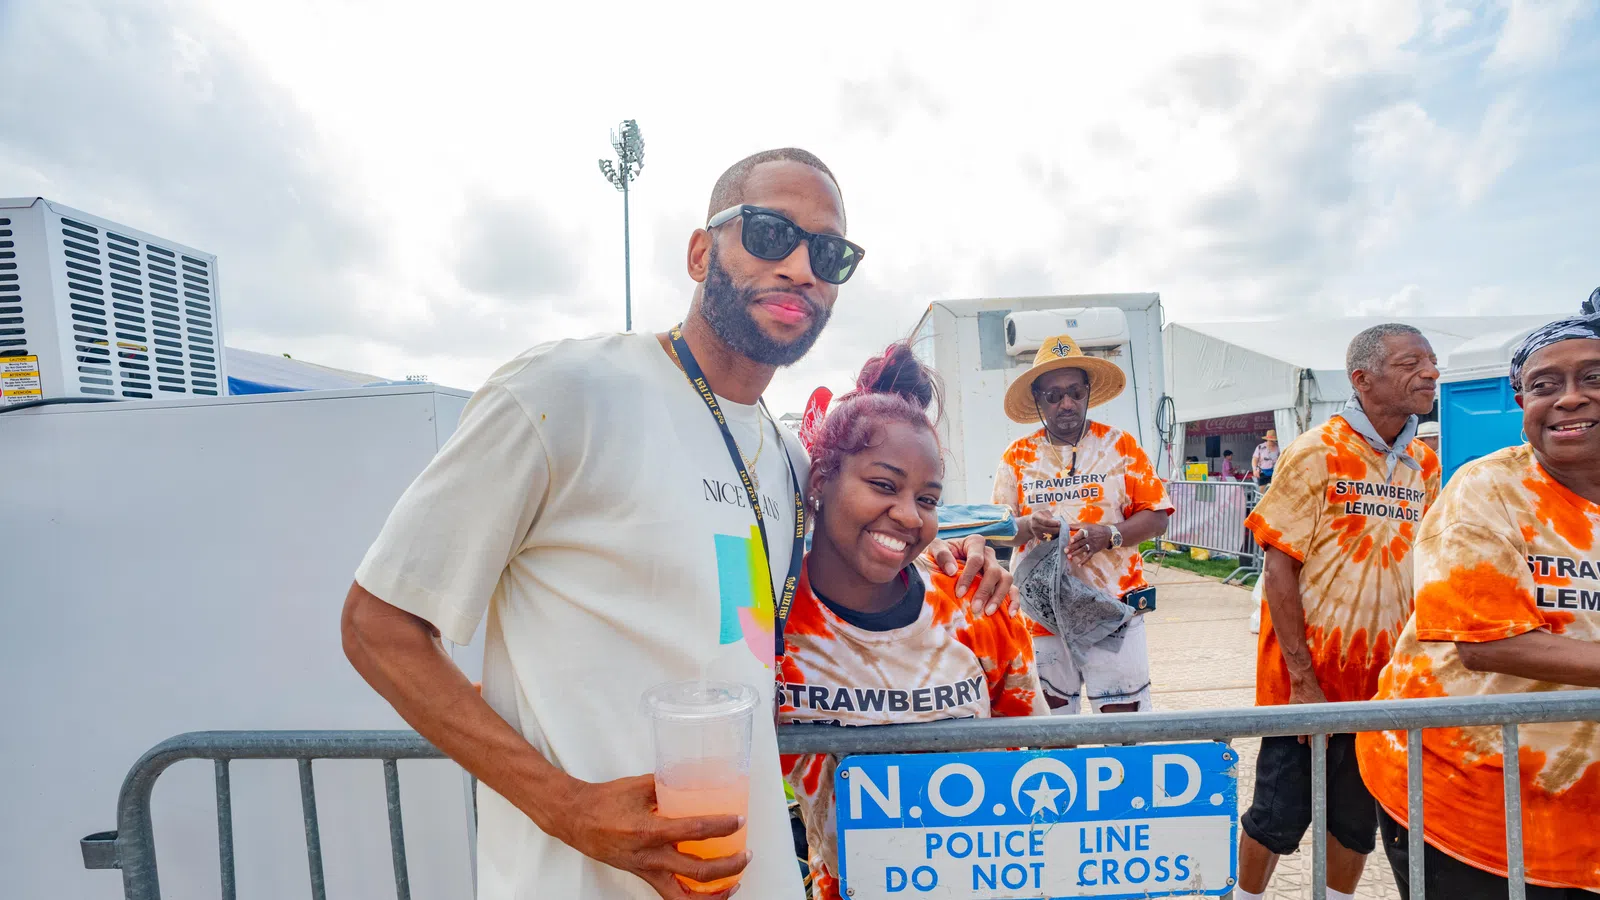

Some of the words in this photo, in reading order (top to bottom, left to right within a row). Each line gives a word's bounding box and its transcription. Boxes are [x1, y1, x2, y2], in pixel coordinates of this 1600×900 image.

[703, 392, 717, 408] JAZZ
[1022, 473, 1107, 491] STRAWBERRY
[1336, 481, 1425, 503] STRAWBERRY
[702, 478, 745, 508] NICE
[1028, 488, 1099, 504] LEMONADE
[1345, 502, 1419, 522] LEMONADE
[1528, 555, 1600, 580] STRA
[782, 591, 793, 608] JAZZ
[780, 606, 789, 619] FEST
[926, 830, 1044, 859] POLICE
[1079, 825, 1150, 854] LINE
[886, 865, 938, 892] DO
[972, 863, 1045, 890] NOT
[1078, 855, 1190, 887] CROSS
